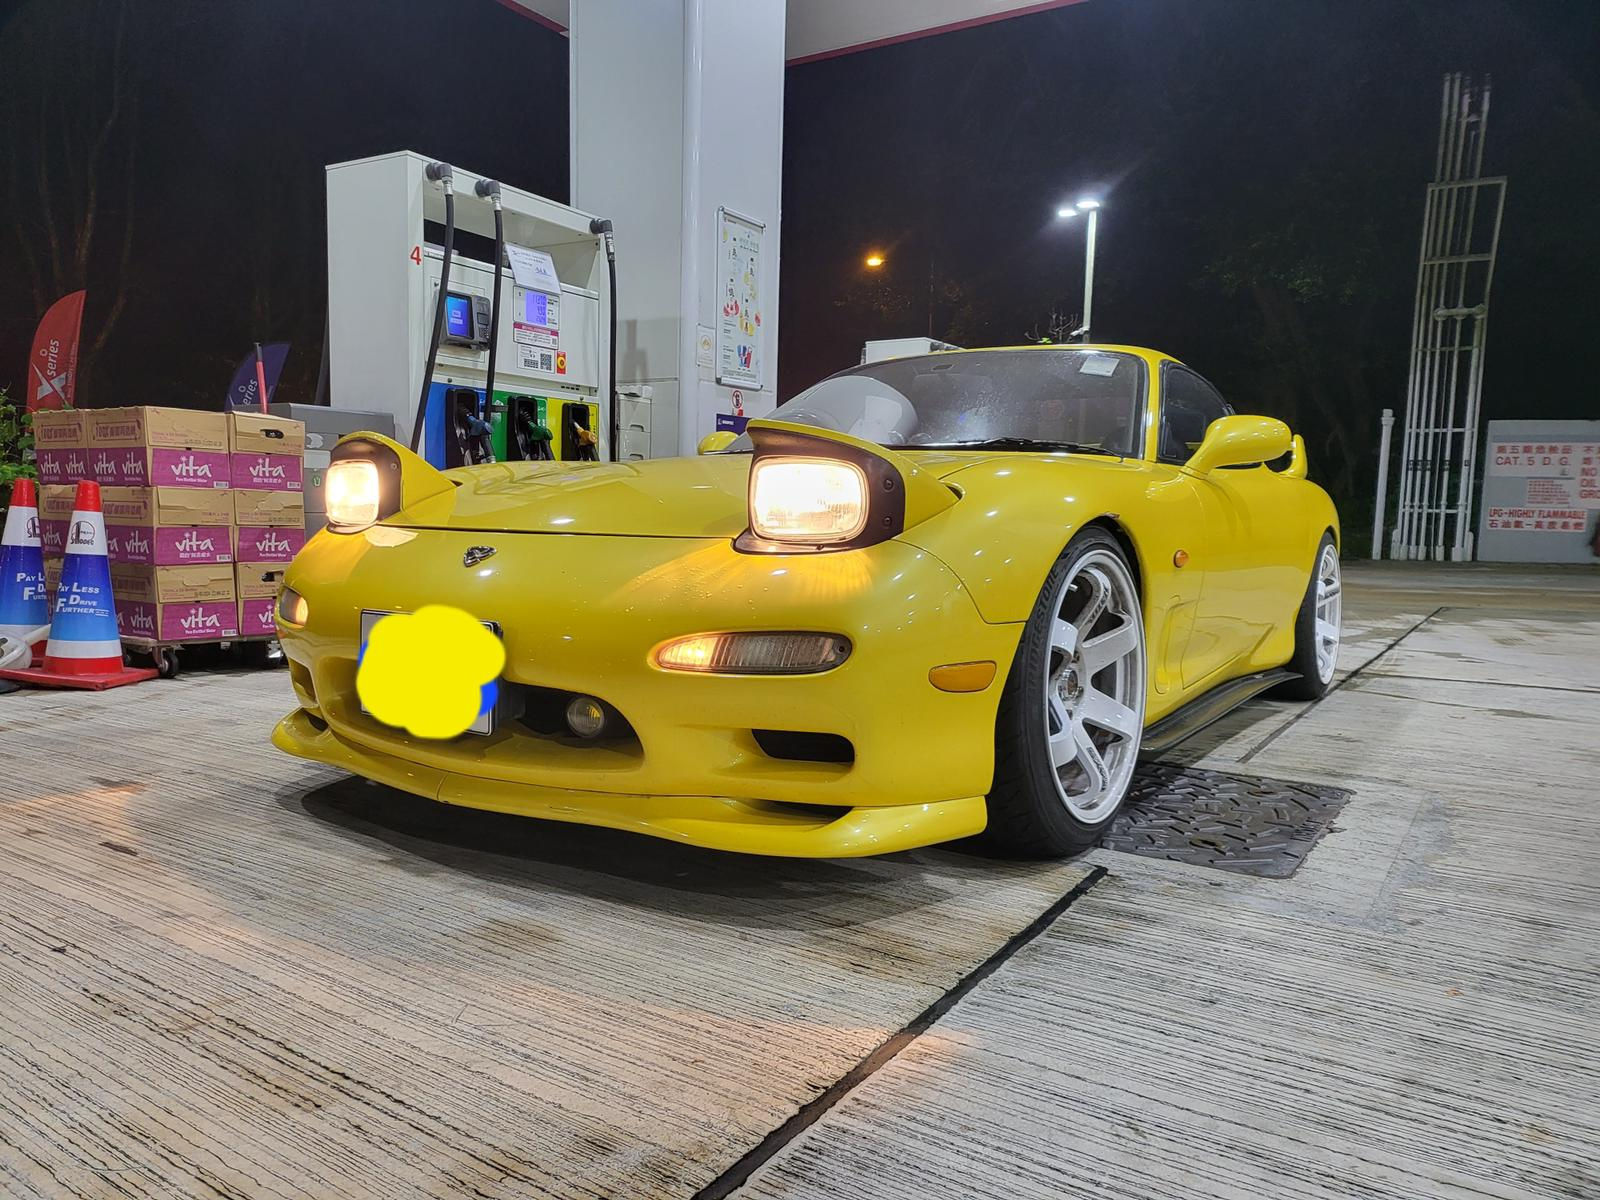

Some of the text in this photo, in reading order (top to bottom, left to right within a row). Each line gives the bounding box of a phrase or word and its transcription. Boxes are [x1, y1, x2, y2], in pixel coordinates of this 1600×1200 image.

[410, 246, 422, 265] 4
[243, 379, 258, 406] eries
[40, 452, 61, 475] vita
[65, 452, 86, 475] vita
[94, 452, 117, 475] vita
[122, 451, 144, 475] vita
[170, 455, 212, 478] vita
[249, 458, 286, 478] vita
[1496, 456, 1521, 466] CAT.
[1527, 456, 1535, 466] 5
[125, 530, 149, 554] vita
[175, 531, 214, 552] vita
[256, 533, 291, 552] vita
[16, 572, 36, 582] PAY
[57, 582, 70, 592] PAY
[72, 582, 100, 594] LESS
[56, 598, 95, 614] FURTHER
[69, 594, 98, 606] DRIVE
[130, 606, 154, 630] vita
[181, 608, 220, 628] vita
[258, 604, 276, 624] vi
